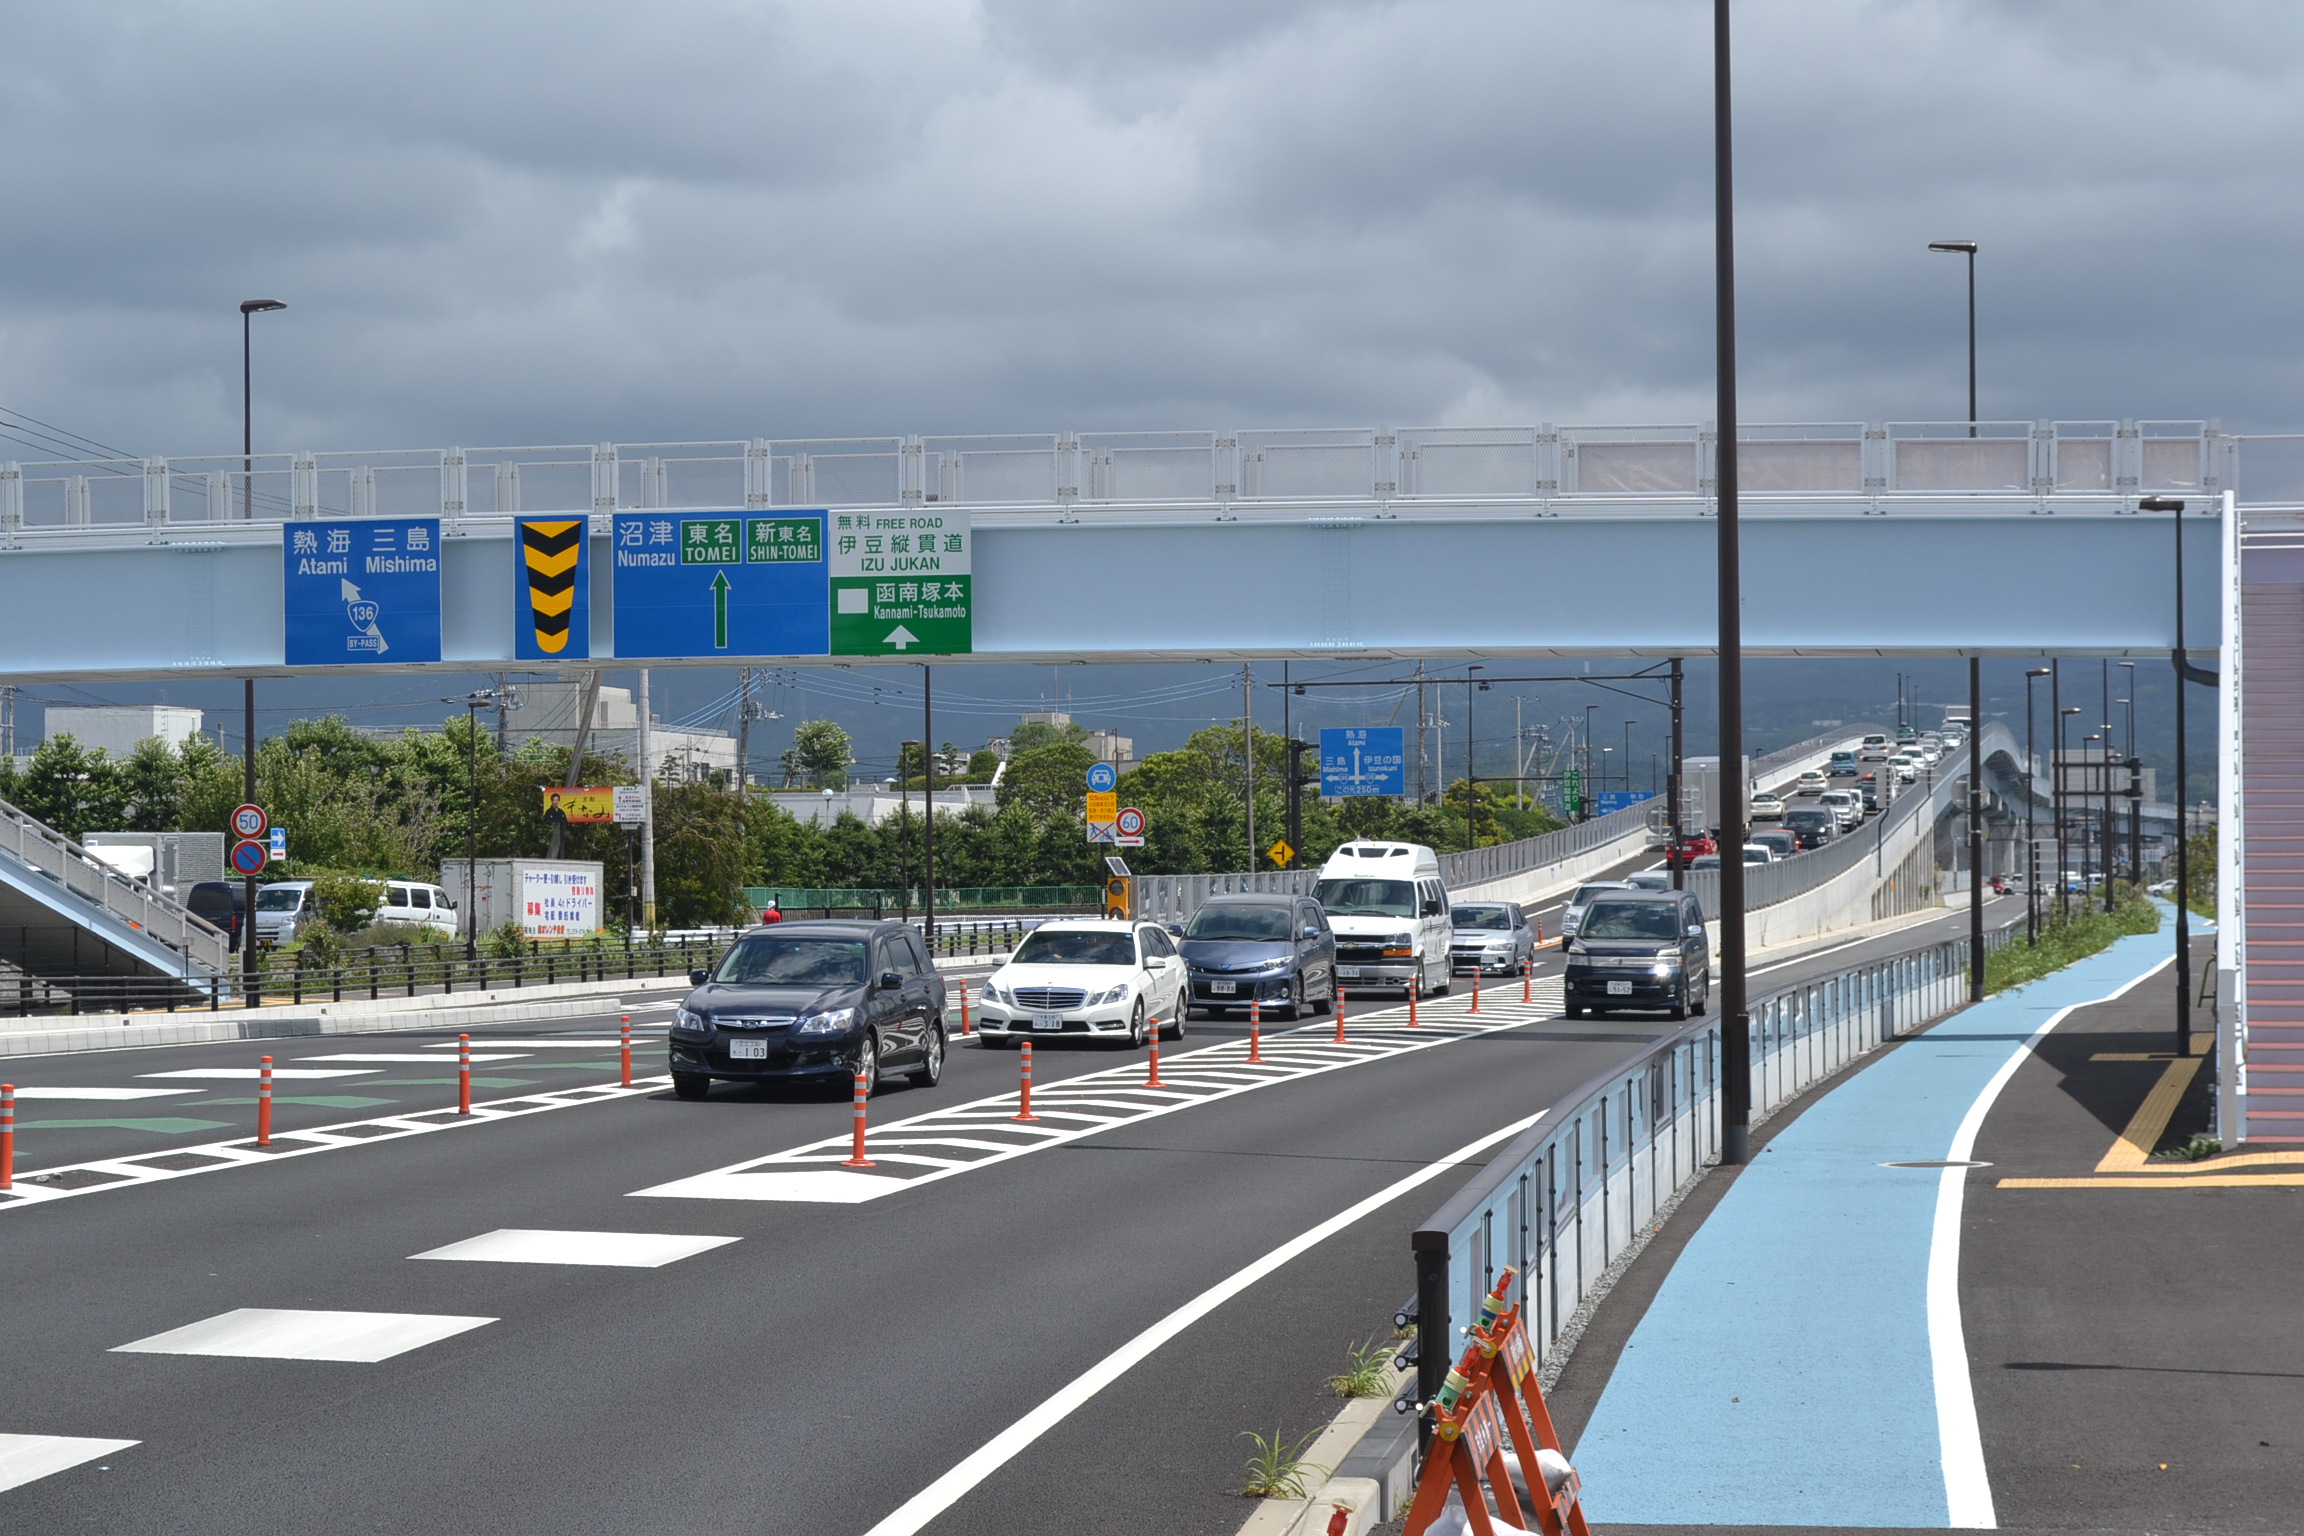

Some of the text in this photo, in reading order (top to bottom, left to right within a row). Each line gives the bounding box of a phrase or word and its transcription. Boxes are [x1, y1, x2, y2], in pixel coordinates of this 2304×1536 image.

[838, 515, 943, 530] 無料 FREE ROAD
[293, 526, 430, 554] 熱海 三島
[619, 520, 674, 546] 沼津
[687, 522, 733, 544] 東名
[755, 521, 812, 543] 新東名
[838, 533, 963, 555] 伊豆縦貫道
[618, 550, 676, 567] Numazu
[685, 546, 736, 562] TOMEI
[750, 544, 818, 561] SHIN-TOMEI
[298, 556, 437, 575] Atami Mishima
[861, 556, 940, 571] IZU JUKAN
[876, 581, 964, 603] 函南塚本
[353, 606, 374, 621] 136
[874, 604, 966, 619] Kannami-Tsukamoto
[350, 638, 377, 648] BY-PASS
[1325, 756, 1346, 766] 三島
[1364, 755, 1402, 765] 伊豆の国
[240, 814, 259, 830] 50
[1122, 816, 1139, 829] 60
